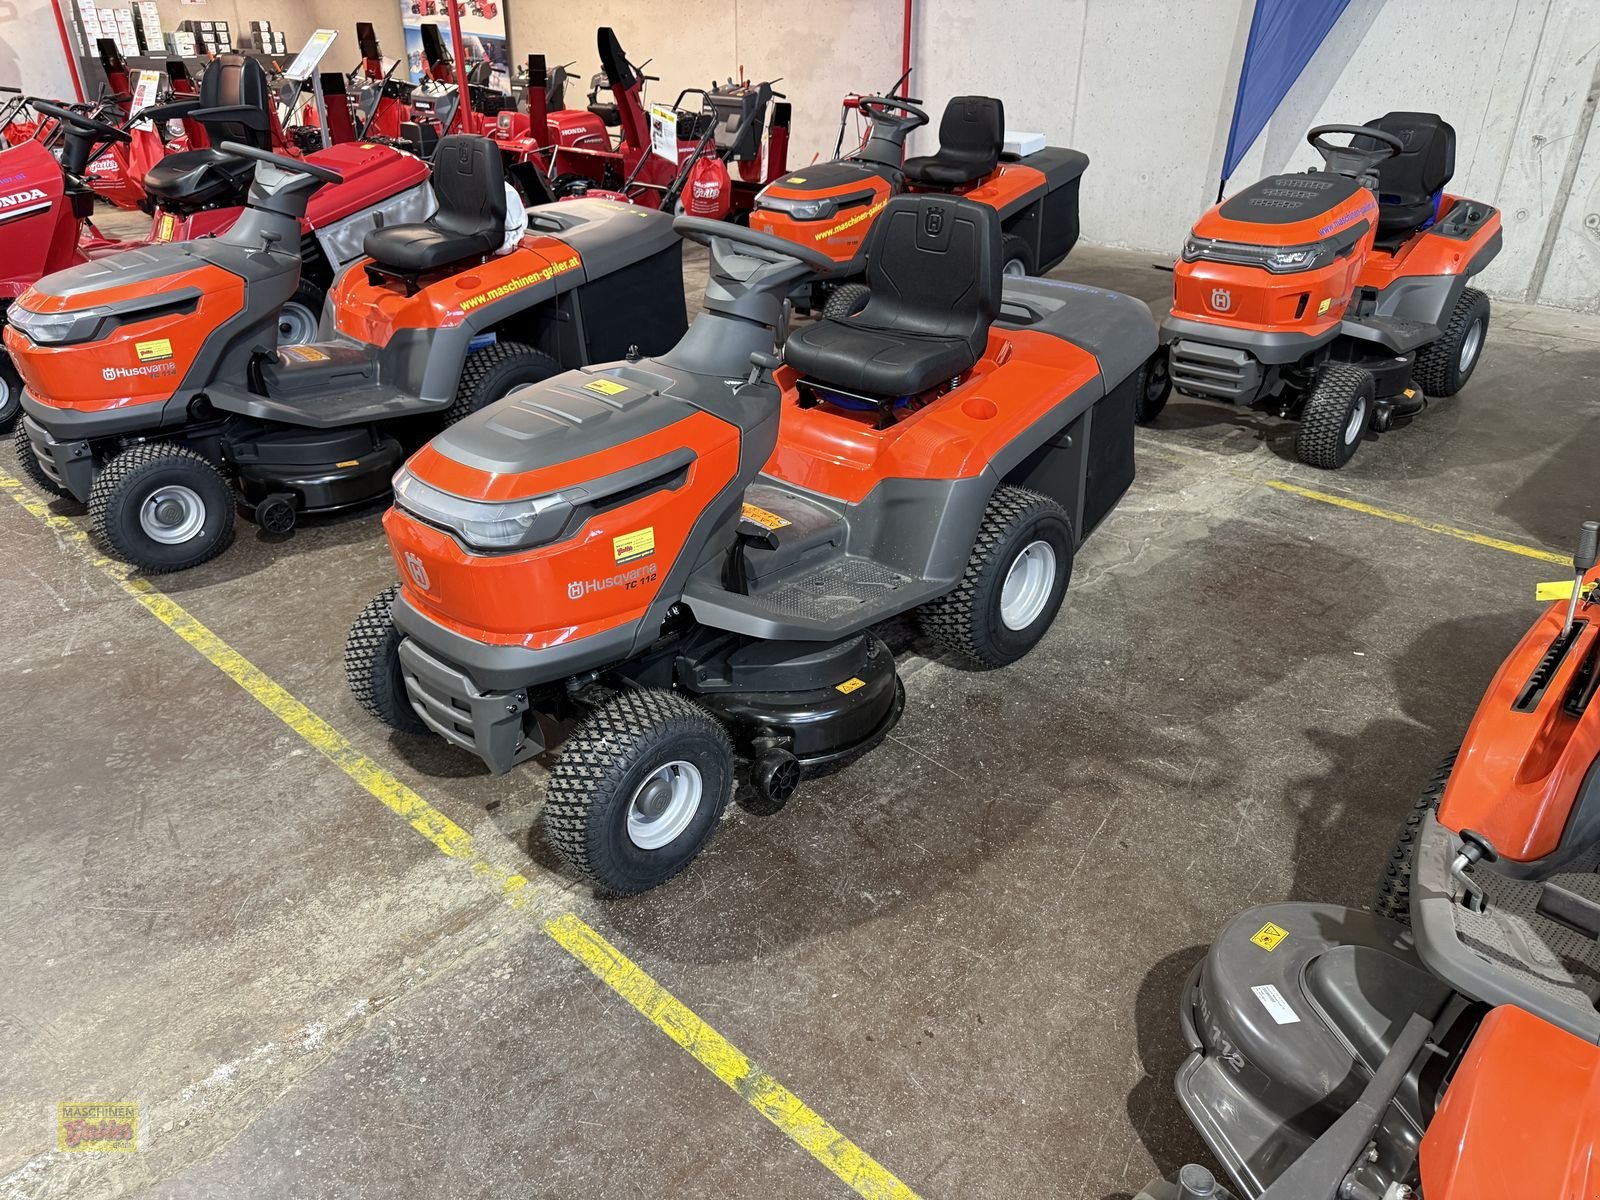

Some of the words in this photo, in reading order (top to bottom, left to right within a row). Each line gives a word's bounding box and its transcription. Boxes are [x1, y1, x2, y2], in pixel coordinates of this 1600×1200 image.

[561, 126, 587, 136] HONDA
[459, 255, 580, 311] www.maschinen-gailer.at
[115, 361, 176, 378] Husqvarna
[585, 562, 657, 594] Husqvarna
[625, 580, 638, 591] TC
[640, 573, 657, 585] 112
